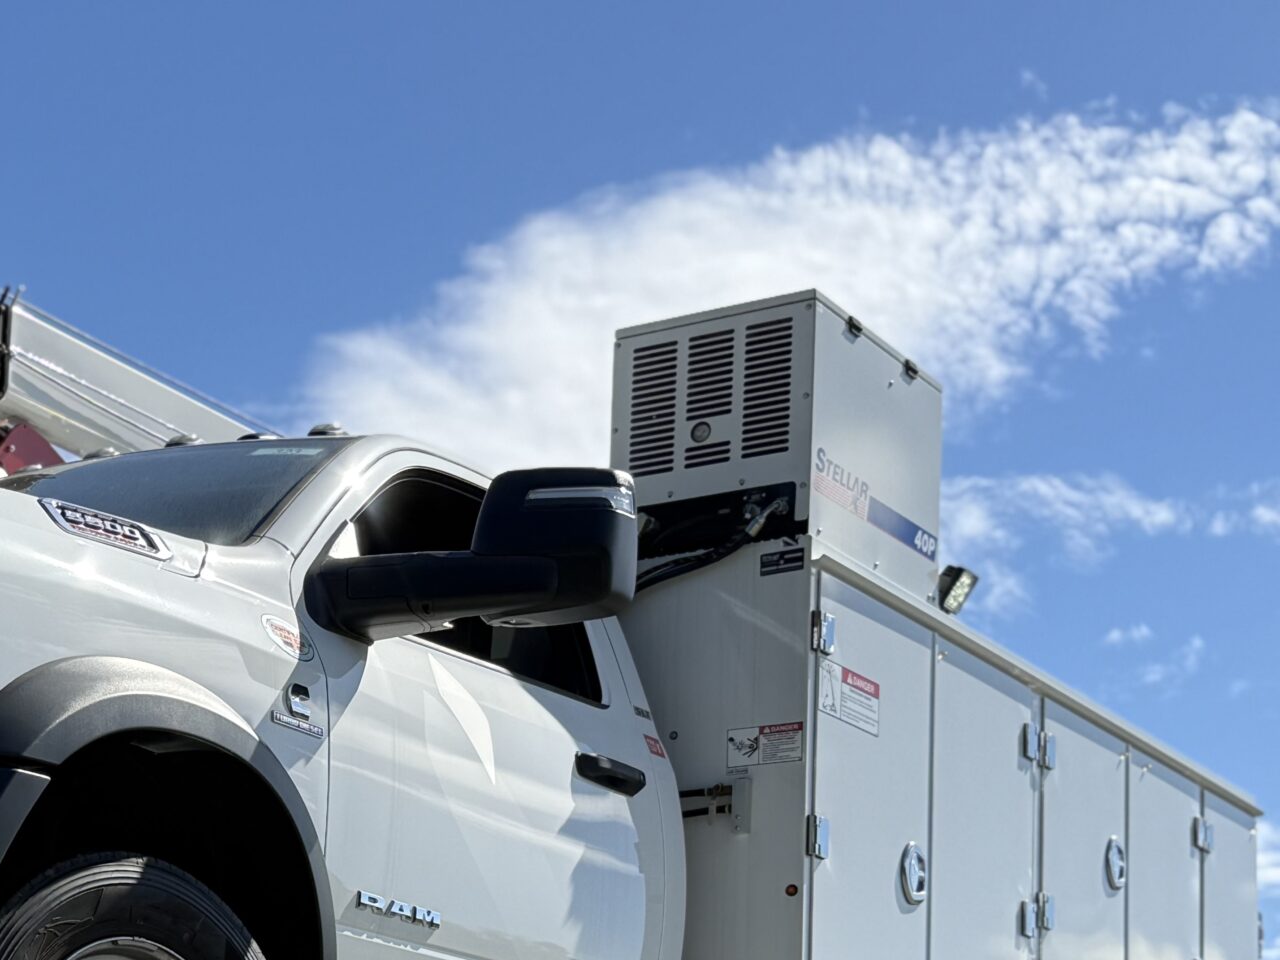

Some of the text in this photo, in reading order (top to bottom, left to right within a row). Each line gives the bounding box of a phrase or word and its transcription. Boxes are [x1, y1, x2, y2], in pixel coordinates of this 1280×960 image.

[815, 447, 870, 502] STELLAR
[914, 529, 937, 557] 40P
[356, 890, 441, 929] RAM
